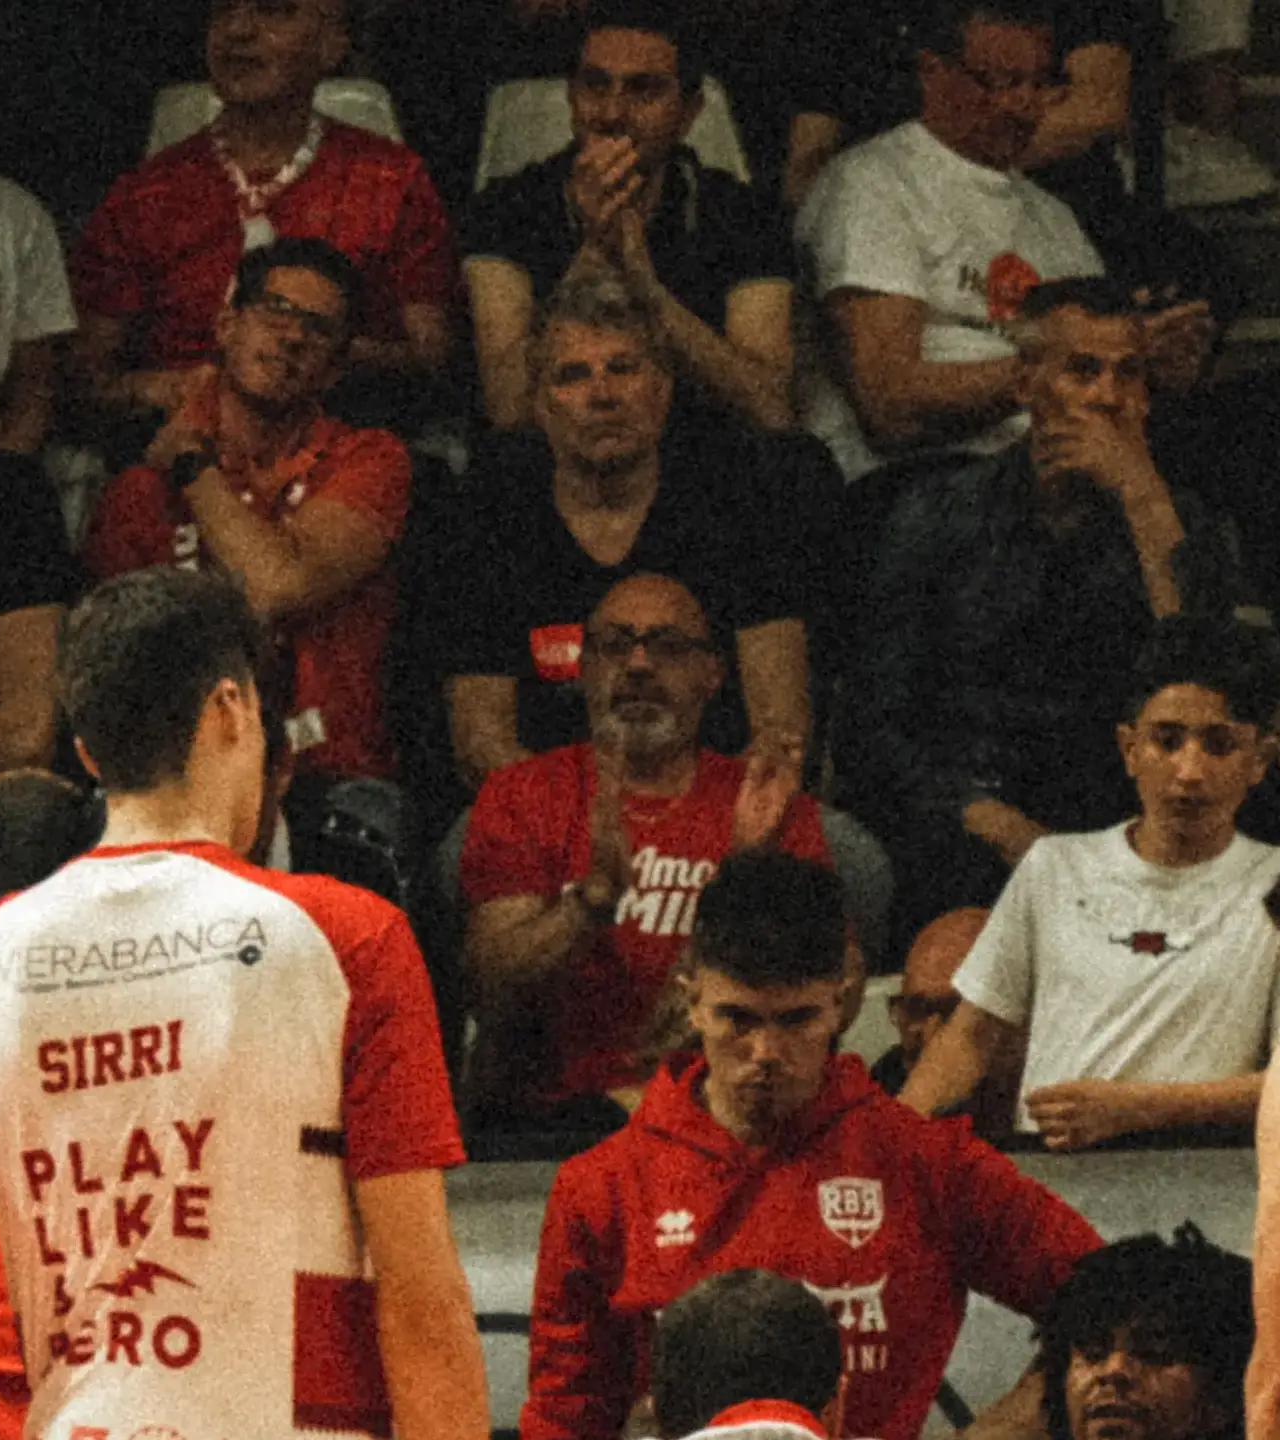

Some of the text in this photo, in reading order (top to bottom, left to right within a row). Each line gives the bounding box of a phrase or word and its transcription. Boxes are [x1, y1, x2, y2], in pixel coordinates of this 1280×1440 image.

[38, 1020, 183, 1094] SIRRI
[21, 1118, 216, 1205] PLAY
[34, 1186, 212, 1266] LIKE
